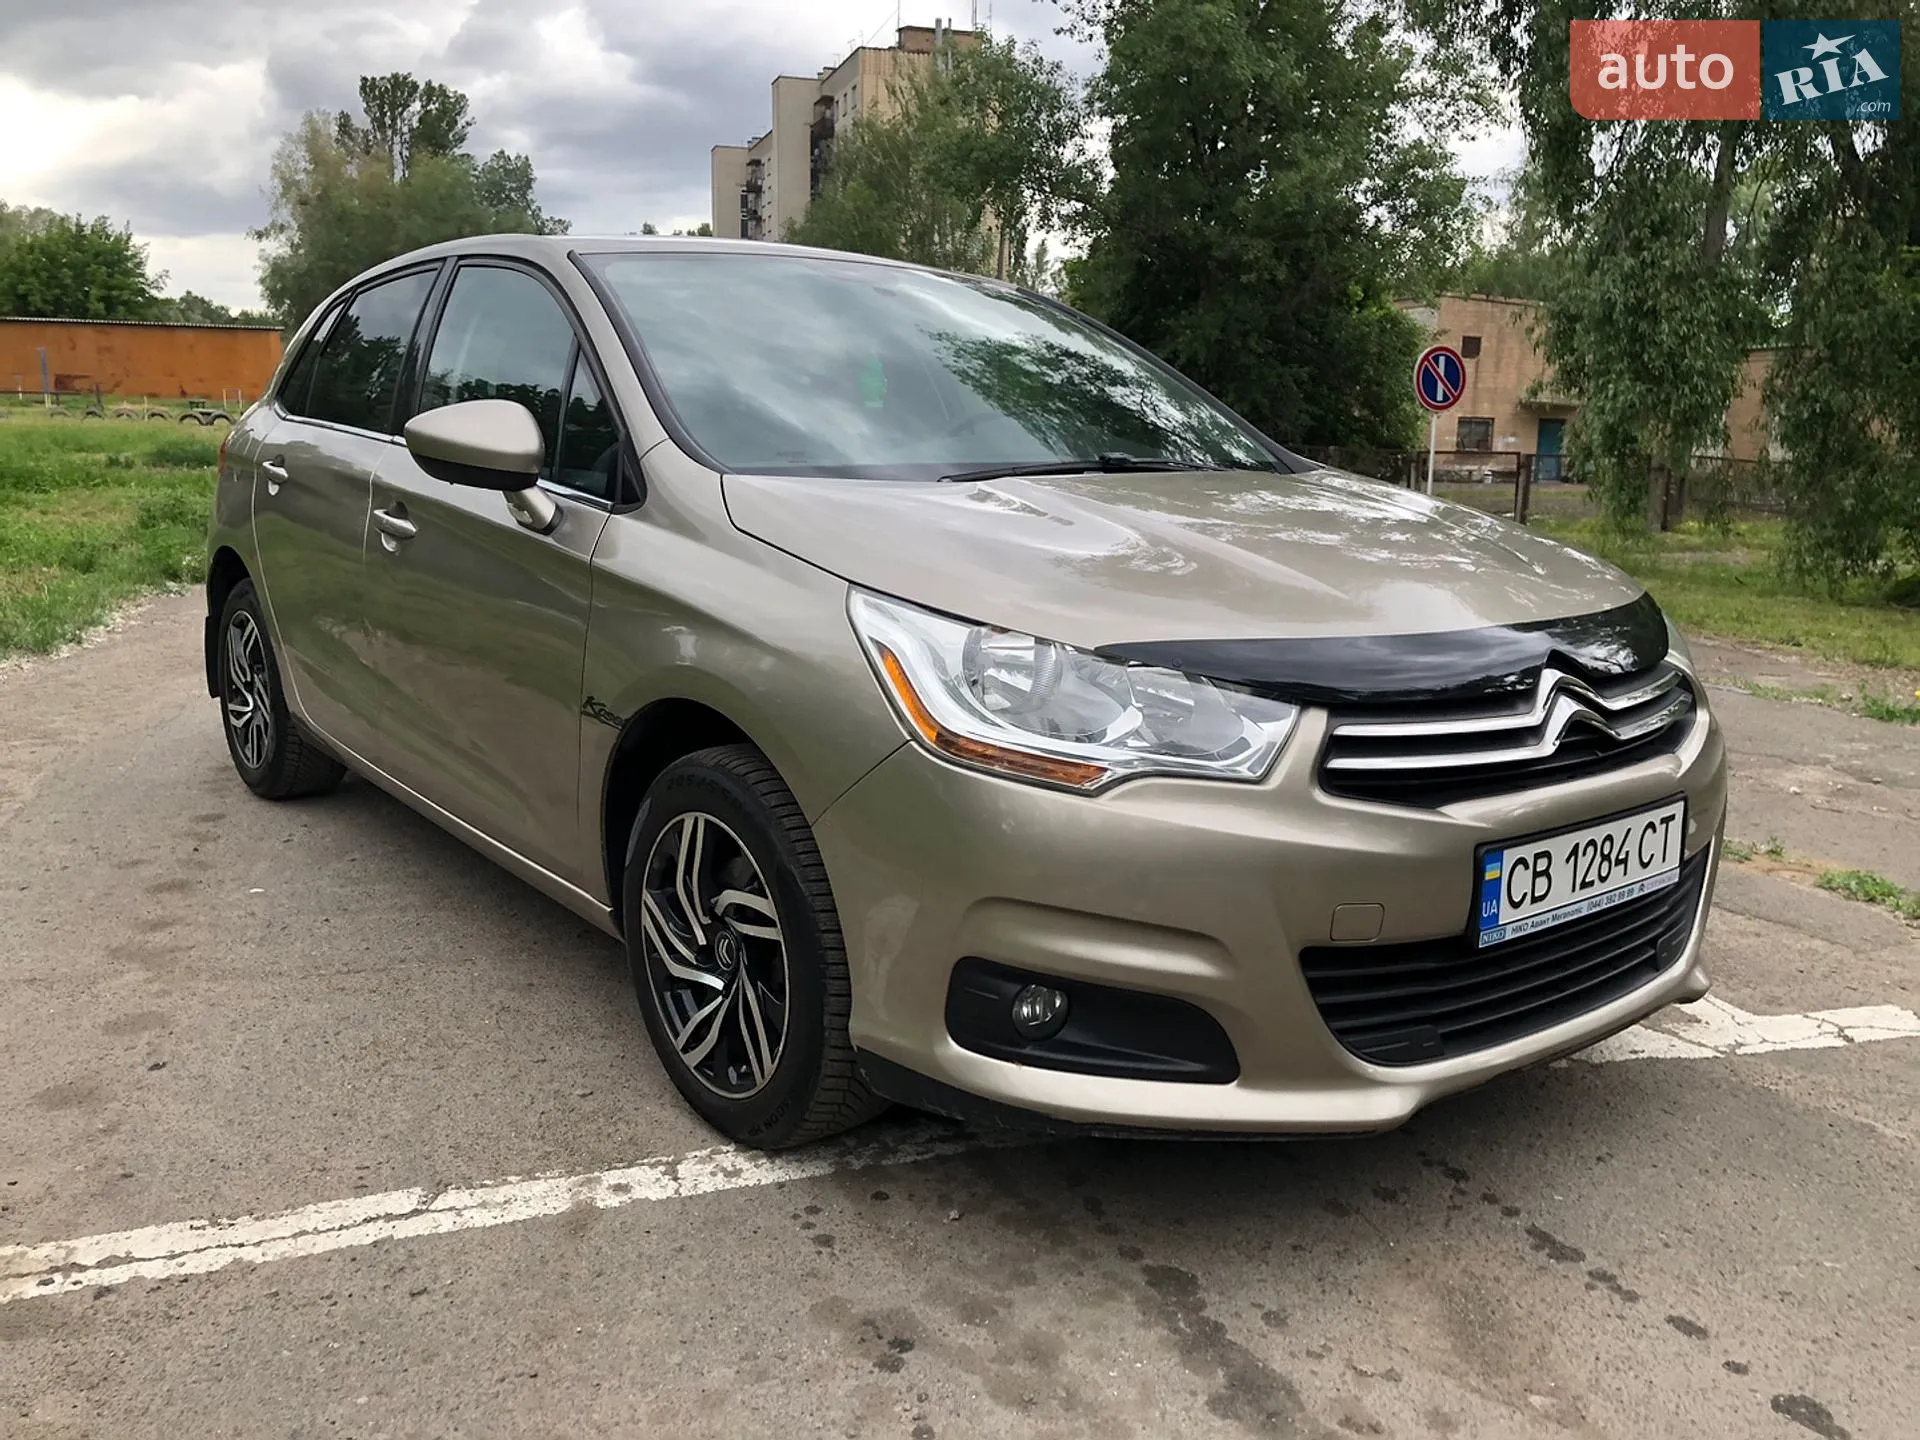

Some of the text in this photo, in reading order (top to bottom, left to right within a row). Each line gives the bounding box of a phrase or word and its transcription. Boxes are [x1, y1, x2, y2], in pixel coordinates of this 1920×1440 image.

[1506, 813, 1676, 910] CB 1284 CT
[1482, 900, 1498, 917] UA
